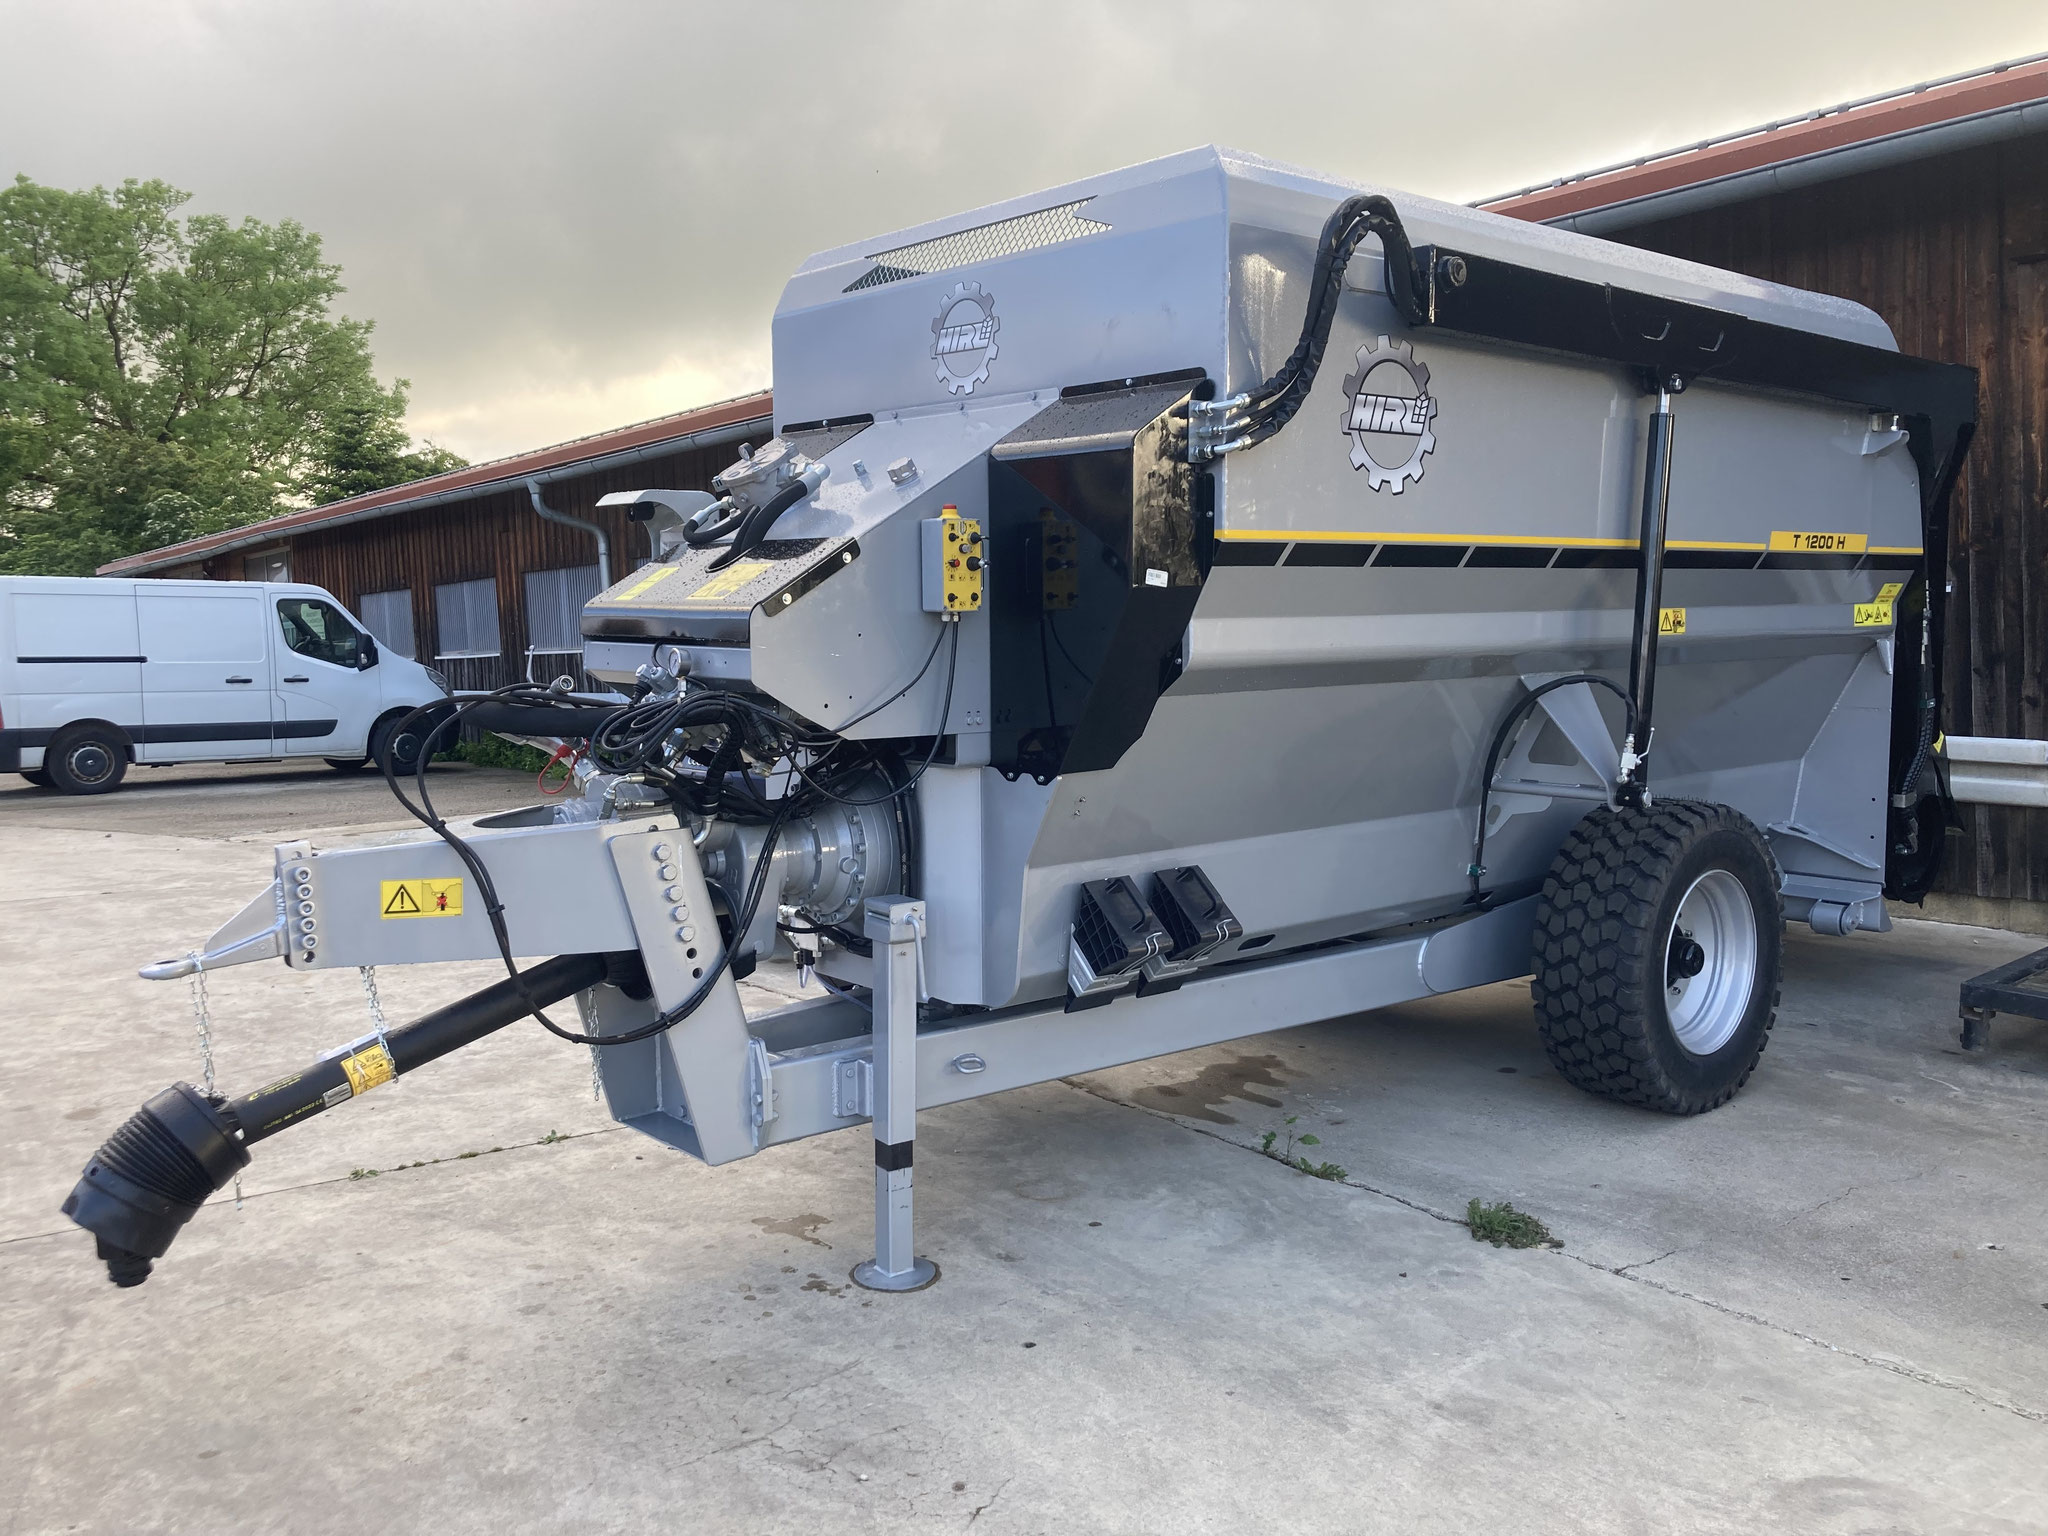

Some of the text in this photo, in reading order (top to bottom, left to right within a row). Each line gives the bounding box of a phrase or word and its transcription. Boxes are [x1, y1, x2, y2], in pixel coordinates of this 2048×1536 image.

[935, 319, 991, 355] HIRL
[1348, 392, 1430, 436] HIRL
[1793, 534, 1846, 550] T 1200 H
